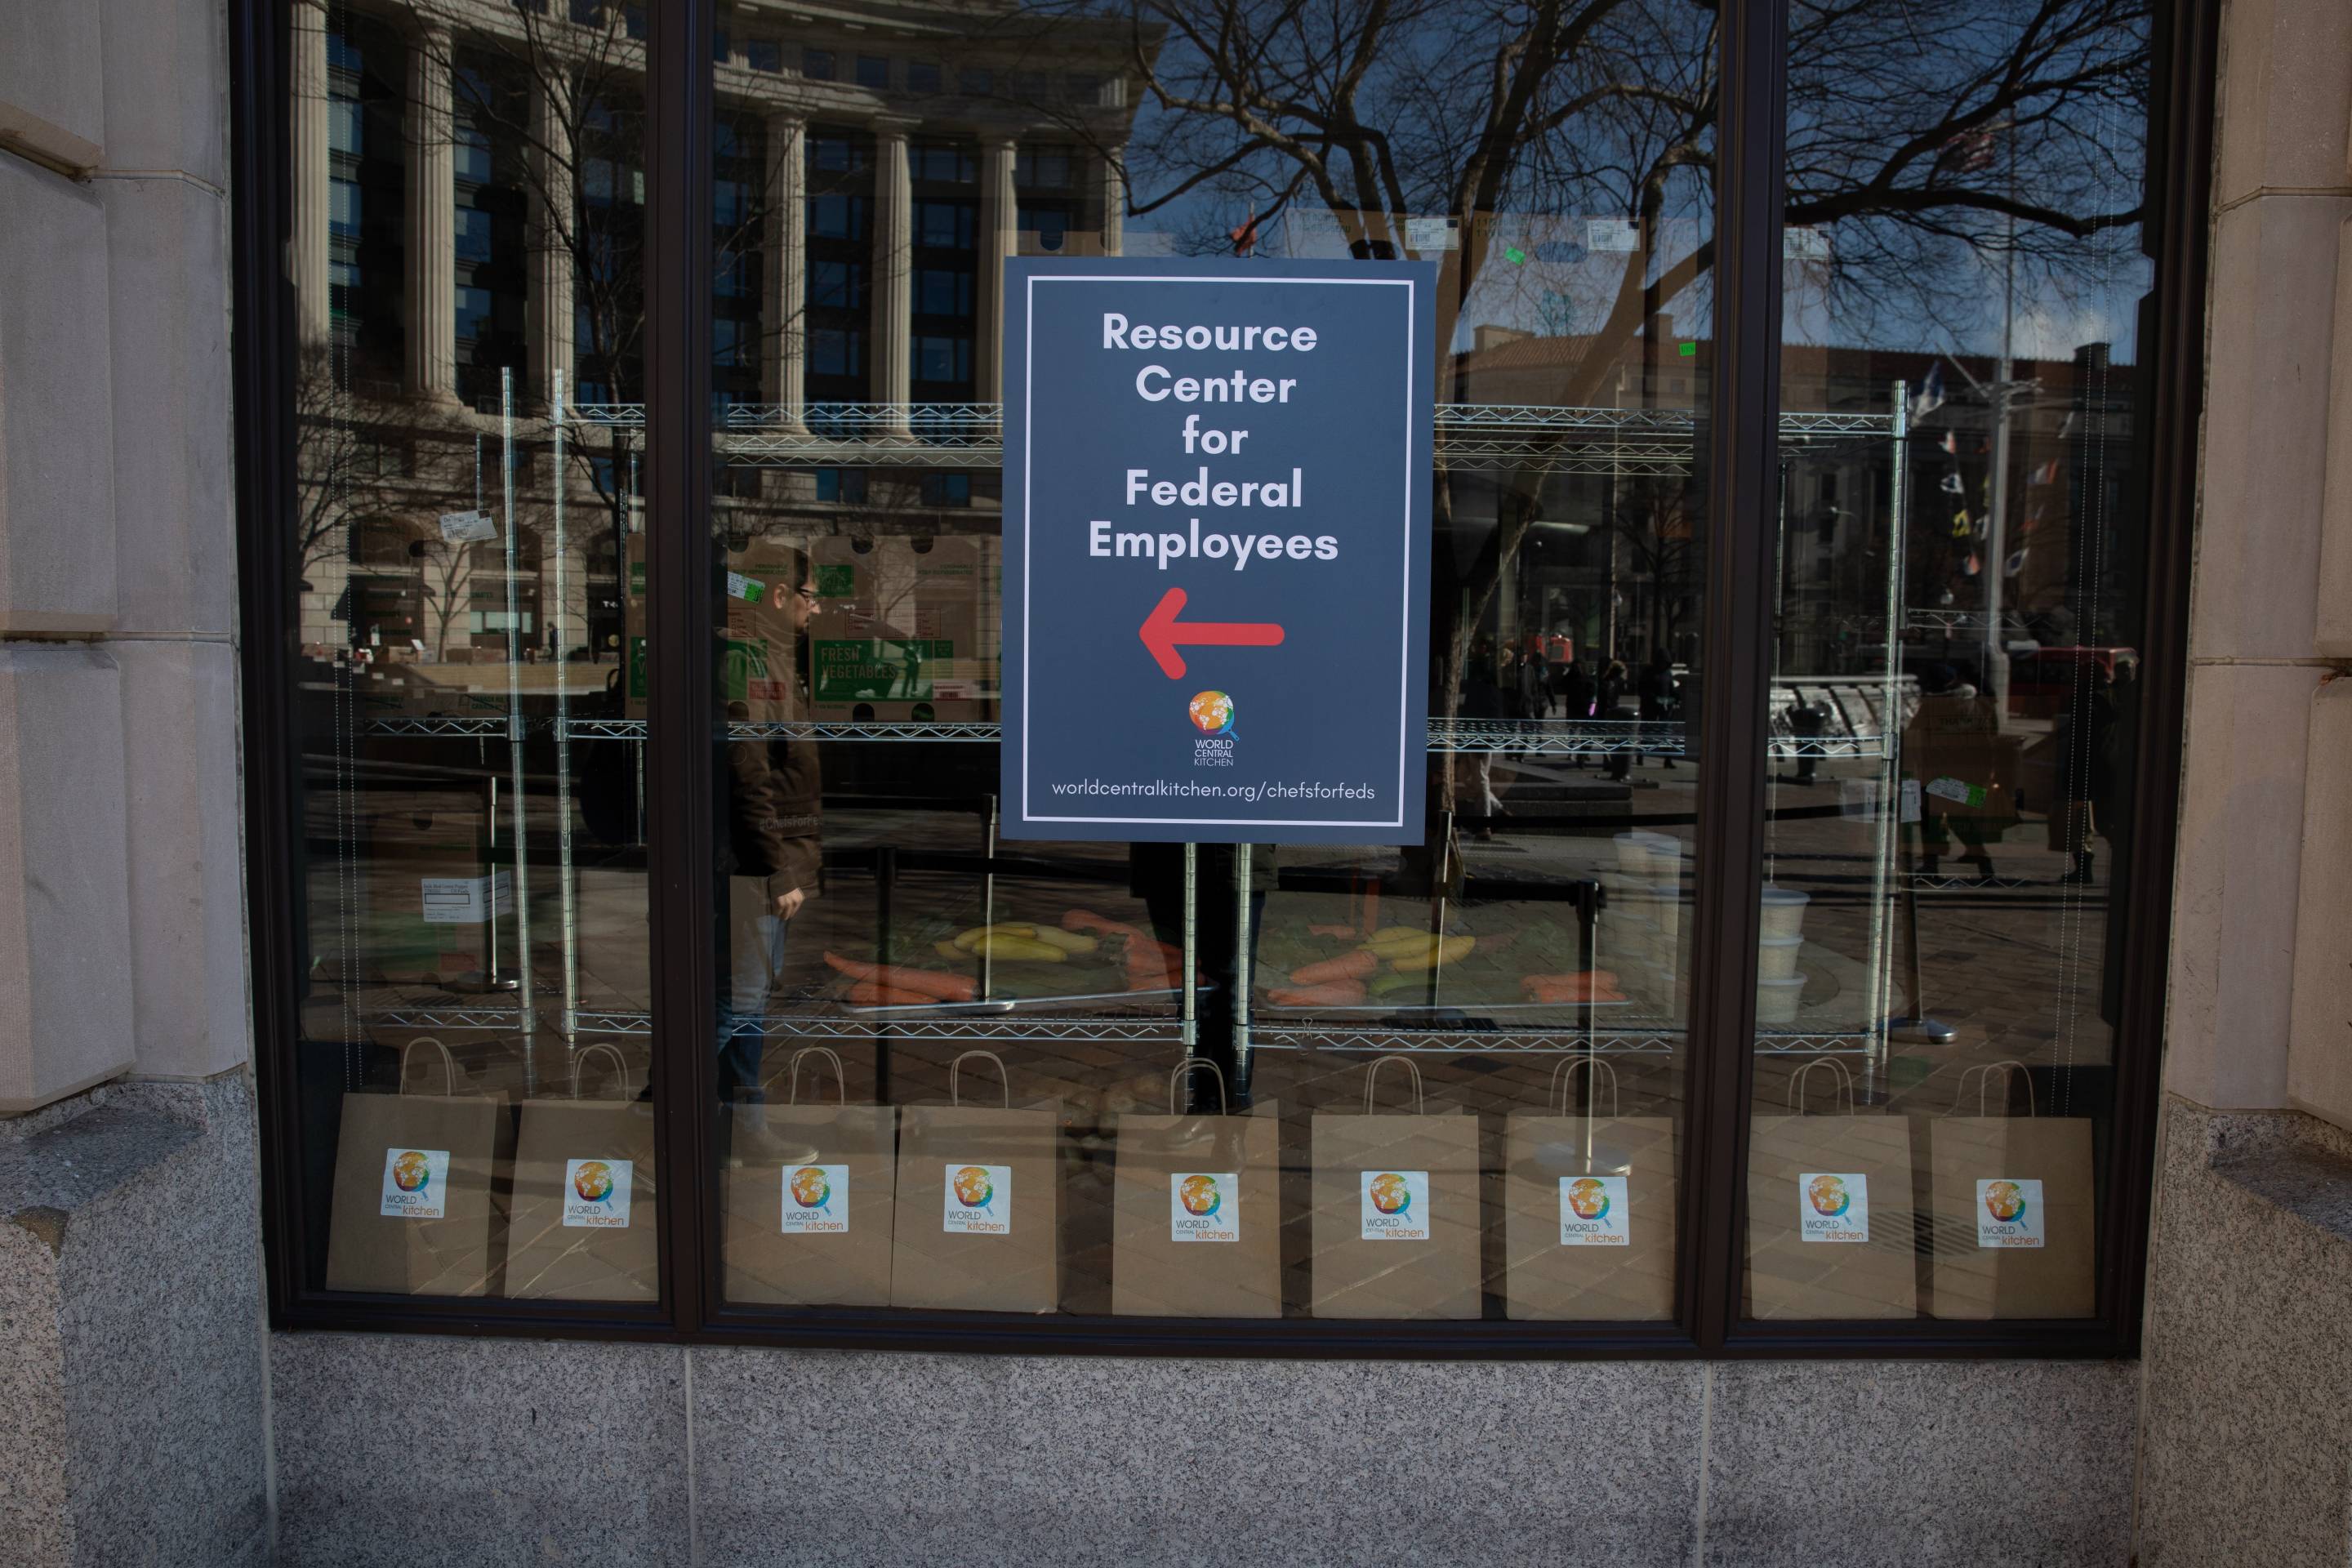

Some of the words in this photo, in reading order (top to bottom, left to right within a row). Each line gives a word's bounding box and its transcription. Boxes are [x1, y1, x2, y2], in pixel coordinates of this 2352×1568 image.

[1102, 312, 1317, 351] Resource
[1135, 364, 1296, 403] Center
[1183, 414, 1249, 455] for
[1126, 466, 1302, 507] Federal
[1089, 519, 1339, 571] Employees
[821, 647, 860, 662] FRESH
[822, 665, 896, 679] VEGETABLES
[1195, 739, 1233, 749] WORLD
[1195, 749, 1233, 758] CENTRAL
[1194, 757, 1233, 767] KITCHEN
[1051, 778, 1375, 802] worldcentralkitchen.org/chefsforfeds
[385, 1195, 417, 1205] WORLD
[403, 1205, 439, 1216] kitchen
[568, 1205, 601, 1214] WORLD
[786, 1212, 819, 1220] WORLD
[948, 1210, 981, 1220] WORLD
[586, 1215, 624, 1226] kitchen
[1176, 1220, 1209, 1228] WORLD
[1366, 1218, 1400, 1227] WORLD
[1806, 1220, 1839, 1229] WORLD
[805, 1221, 844, 1231] kitchen
[967, 1221, 1004, 1232] kitchen
[1565, 1223, 1599, 1232] WORLD
[1982, 1226, 2016, 1235] WORLD
[1196, 1230, 1234, 1240] kitchen
[1386, 1228, 1424, 1237] kitchen
[1825, 1230, 1864, 1240] kitchen
[1585, 1233, 1624, 1243] kitchen
[2002, 1236, 2039, 1245] kitchen
